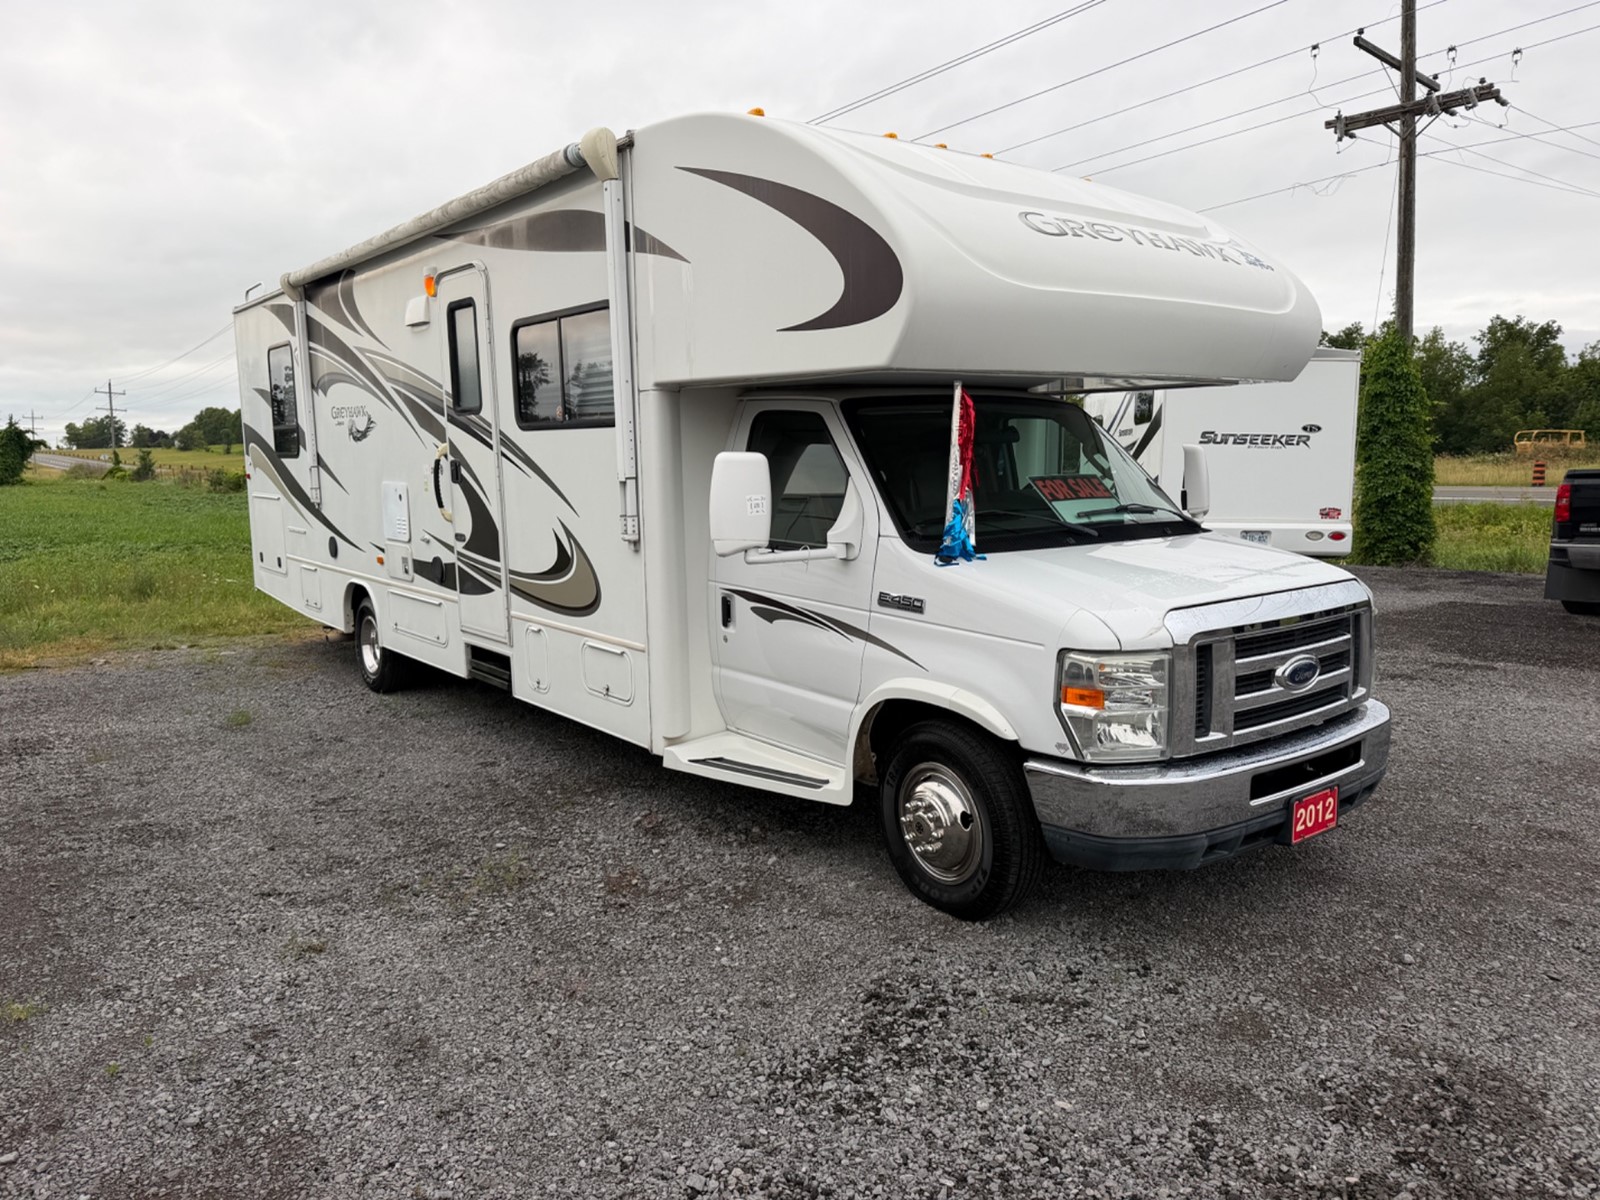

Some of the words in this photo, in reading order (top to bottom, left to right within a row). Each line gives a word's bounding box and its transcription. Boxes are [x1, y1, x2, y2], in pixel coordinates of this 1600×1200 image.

[1018, 211, 1241, 265] GREYHAWK
[1199, 431, 1311, 449] SUNSEEKER
[1034, 480, 1073, 500] FOR
[1067, 477, 1113, 498] SALE
[1296, 797, 1335, 832] 2012
